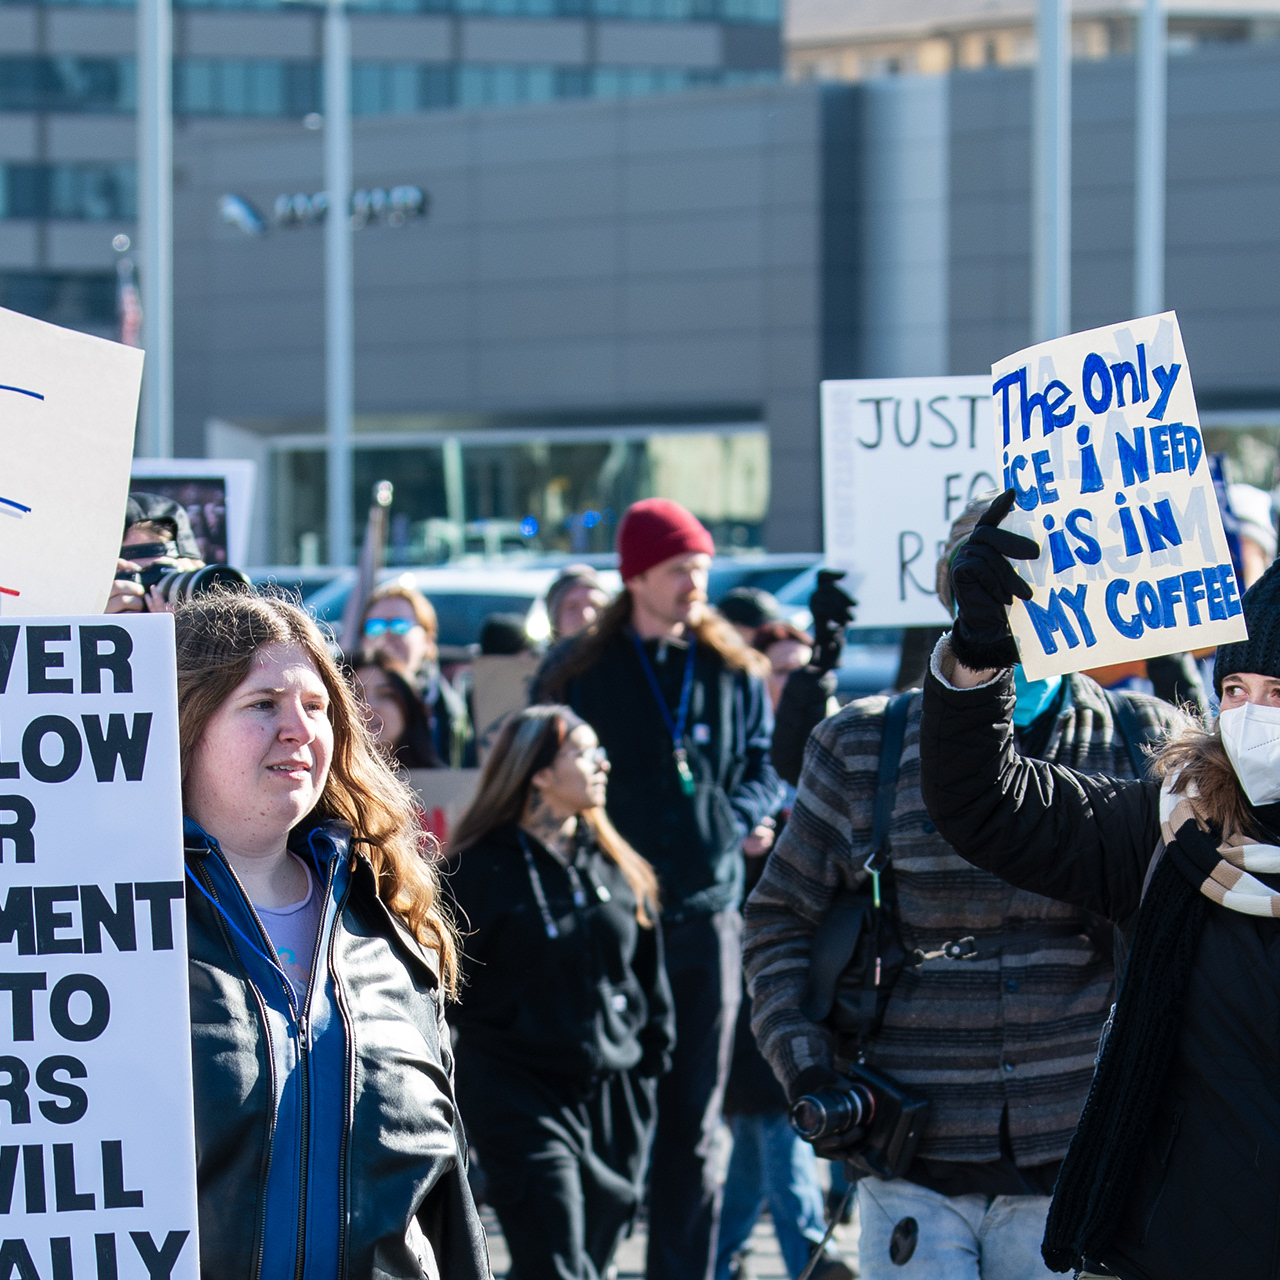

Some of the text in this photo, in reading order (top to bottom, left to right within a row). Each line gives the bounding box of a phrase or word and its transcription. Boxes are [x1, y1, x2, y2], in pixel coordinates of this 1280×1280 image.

[992, 342, 1182, 450] The Only
[1115, 420, 1203, 489] NEED
[1022, 562, 1244, 656] MY COFFEE
